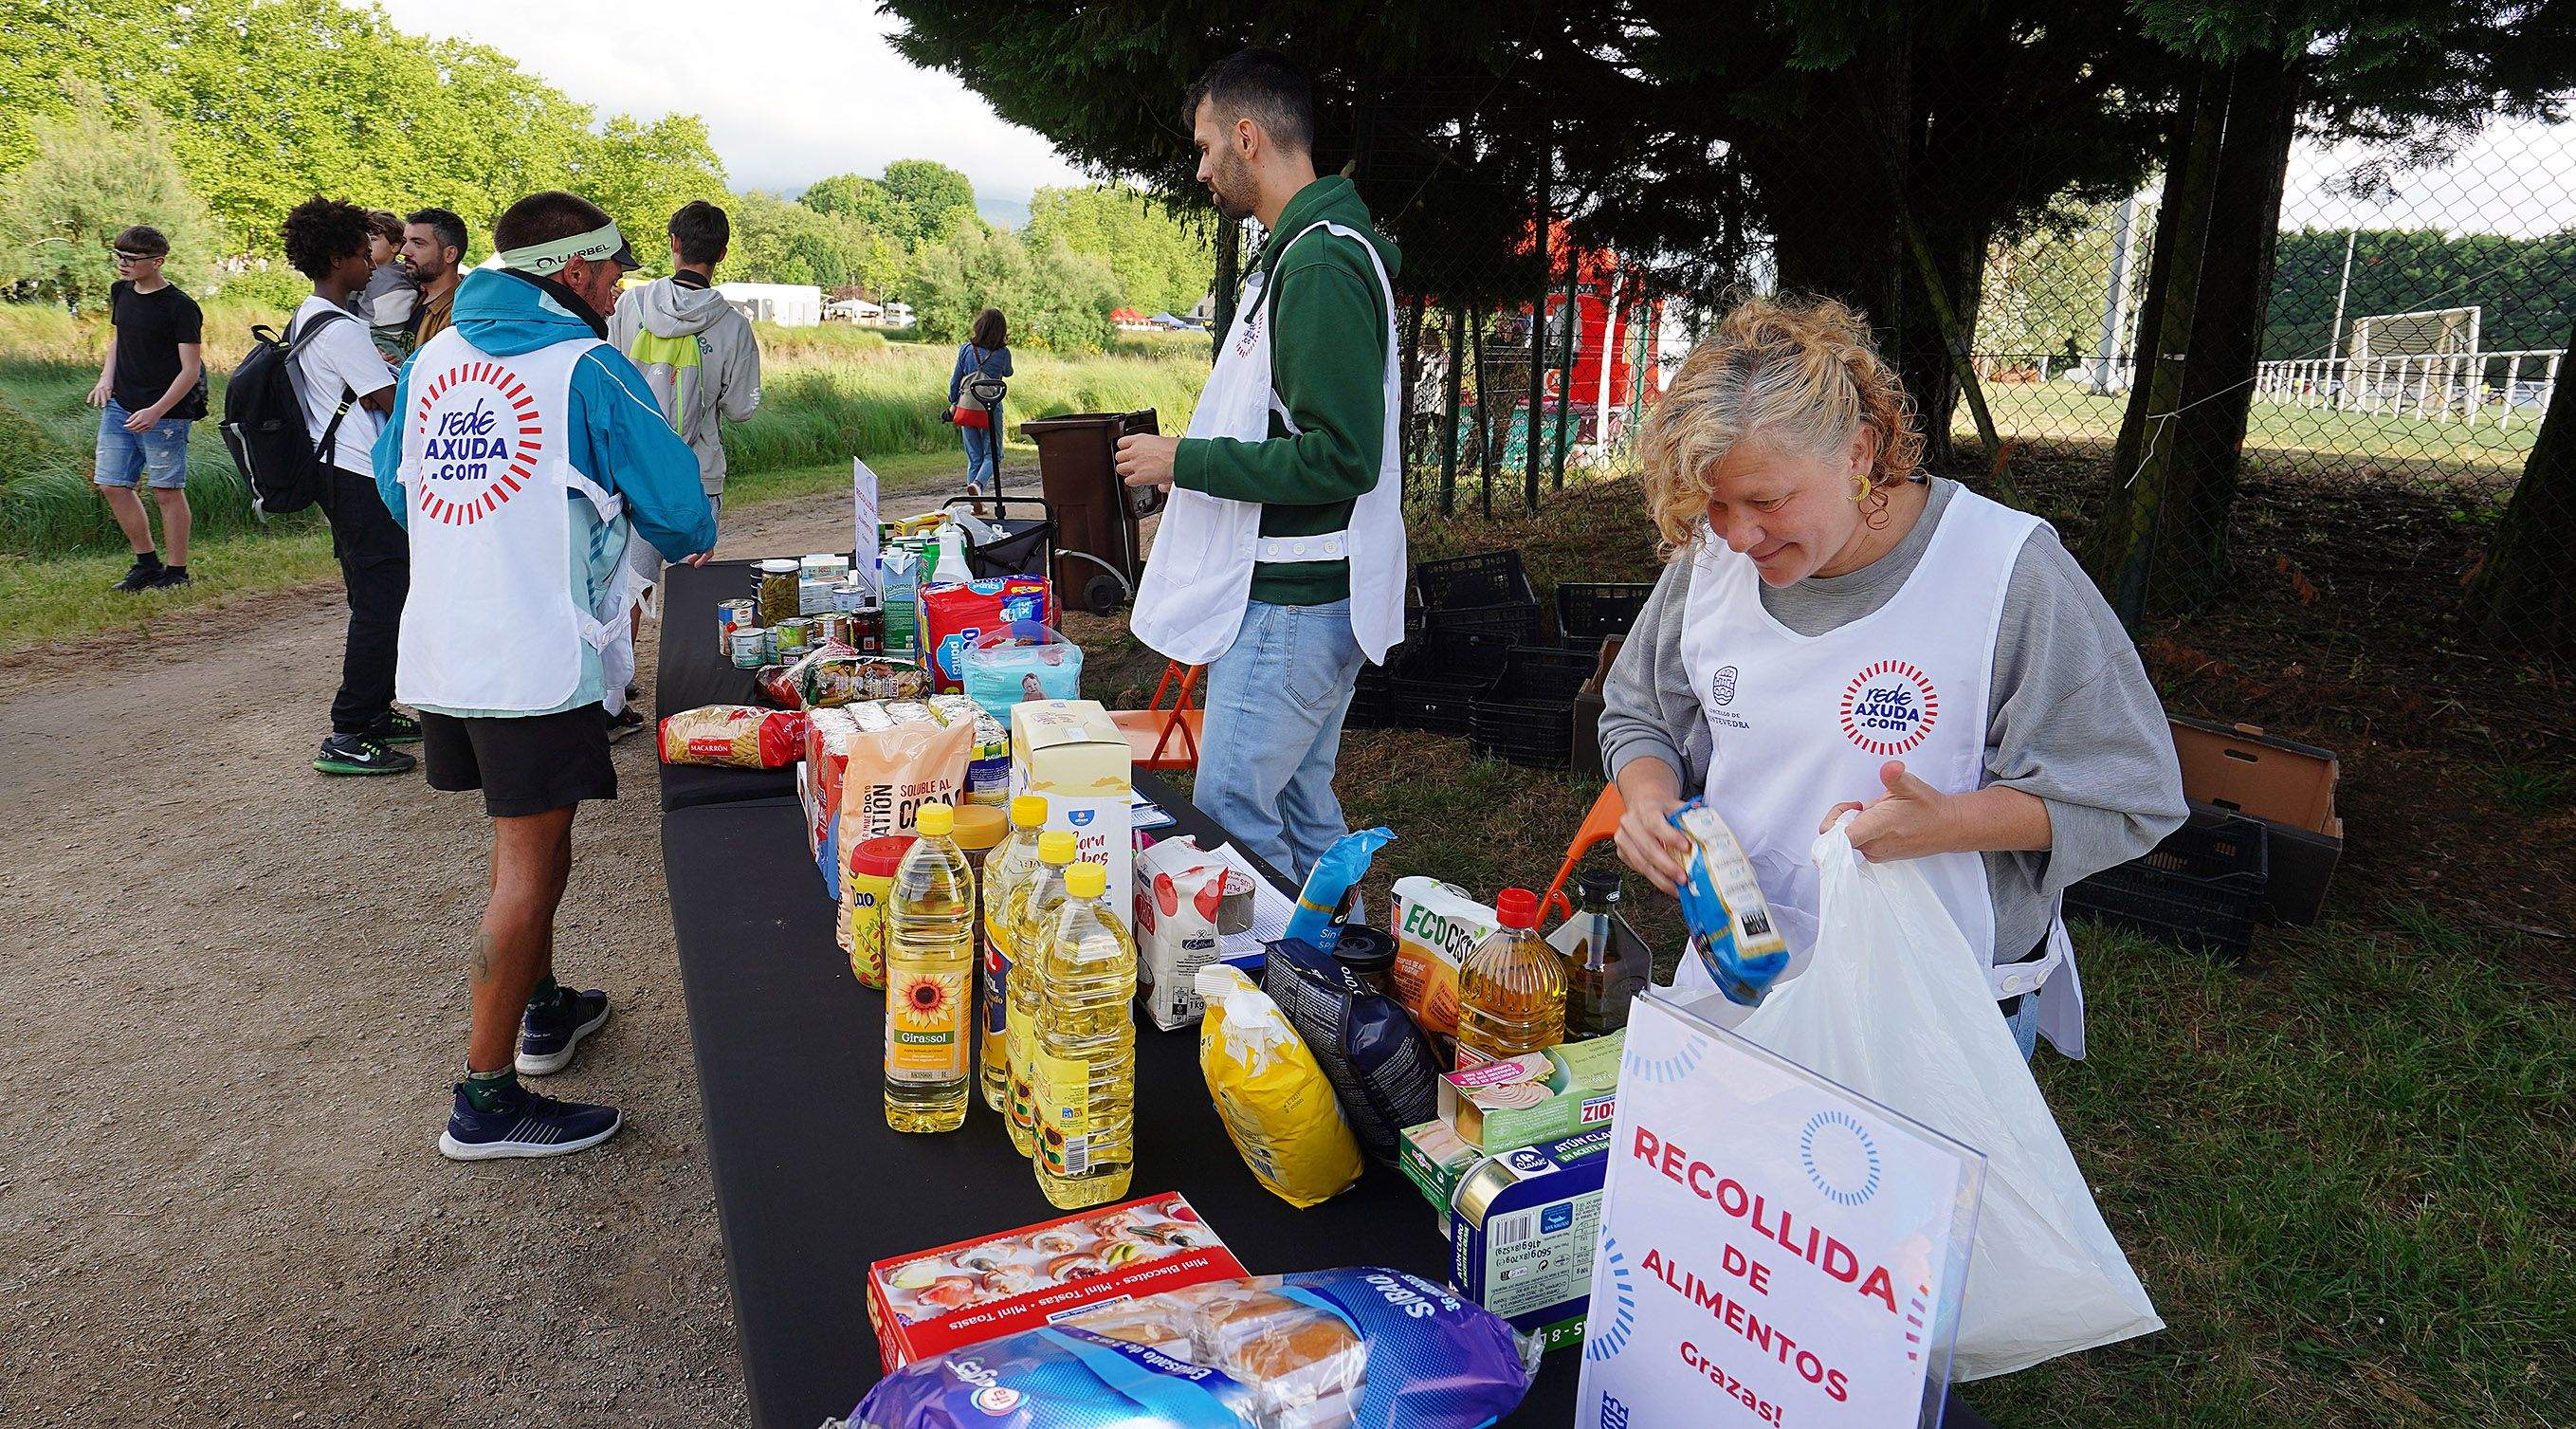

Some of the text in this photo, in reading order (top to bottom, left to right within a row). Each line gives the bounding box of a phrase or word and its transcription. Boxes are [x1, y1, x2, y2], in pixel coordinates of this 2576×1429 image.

[438, 398, 498, 436] rede
[425, 438, 508, 461] AXUDA
[431, 463, 487, 481] .com
[1866, 683, 1913, 705] rede
[1854, 703, 1920, 723] AXUDA
[1861, 717, 1908, 732] .com
[690, 743, 728, 752] MACARRÓN
[900, 779, 952, 797] SOLUBLE AL
[871, 785, 893, 839] ATION
[1320, 928, 1337, 939] Sin
[902, 1033, 946, 1043] Girassol
[1582, 1104, 1615, 1123] OIZ
[1555, 1137, 1588, 1153] ATÚN
[1561, 1153, 1574, 1162] EN
[1574, 1145, 1599, 1157] ACEITE
[1517, 1157, 1547, 1170] Classic
[1634, 1126, 1897, 1315] RECOLLIDA
[1123, 1263, 1180, 1286] Biscottes
[1181, 1257, 1209, 1275] Mini
[1722, 1242, 1771, 1297] DE
[1038, 1289, 1084, 1308] Tostas
[1085, 1282, 1112, 1298] Mini
[1440, 1296, 1461, 1312] 36
[949, 1311, 996, 1331] Toasts
[997, 1305, 1027, 1322] Mini
[1641, 1248, 1849, 1402] ALIMENTOS
[1552, 1328, 1562, 1342] 8
[1680, 1341, 1783, 1429] Grazas!
